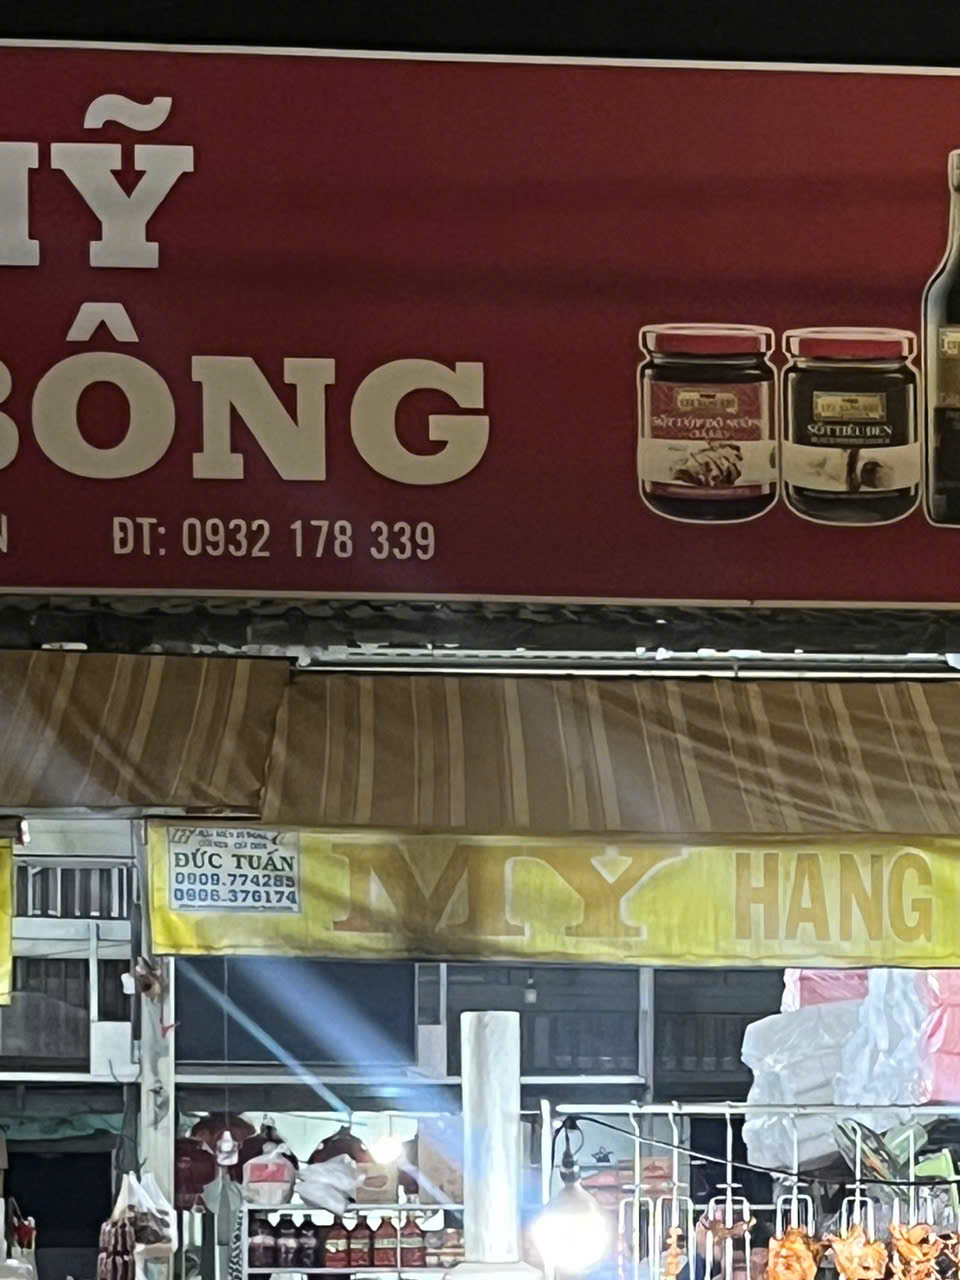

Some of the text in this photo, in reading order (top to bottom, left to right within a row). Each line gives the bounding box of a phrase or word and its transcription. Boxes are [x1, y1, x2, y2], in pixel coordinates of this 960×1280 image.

[0, 302, 490, 486] ÔNG
[112, 516, 436, 561] ĐT: 0932 178 339
[174, 848, 222, 869] ĐỨC
